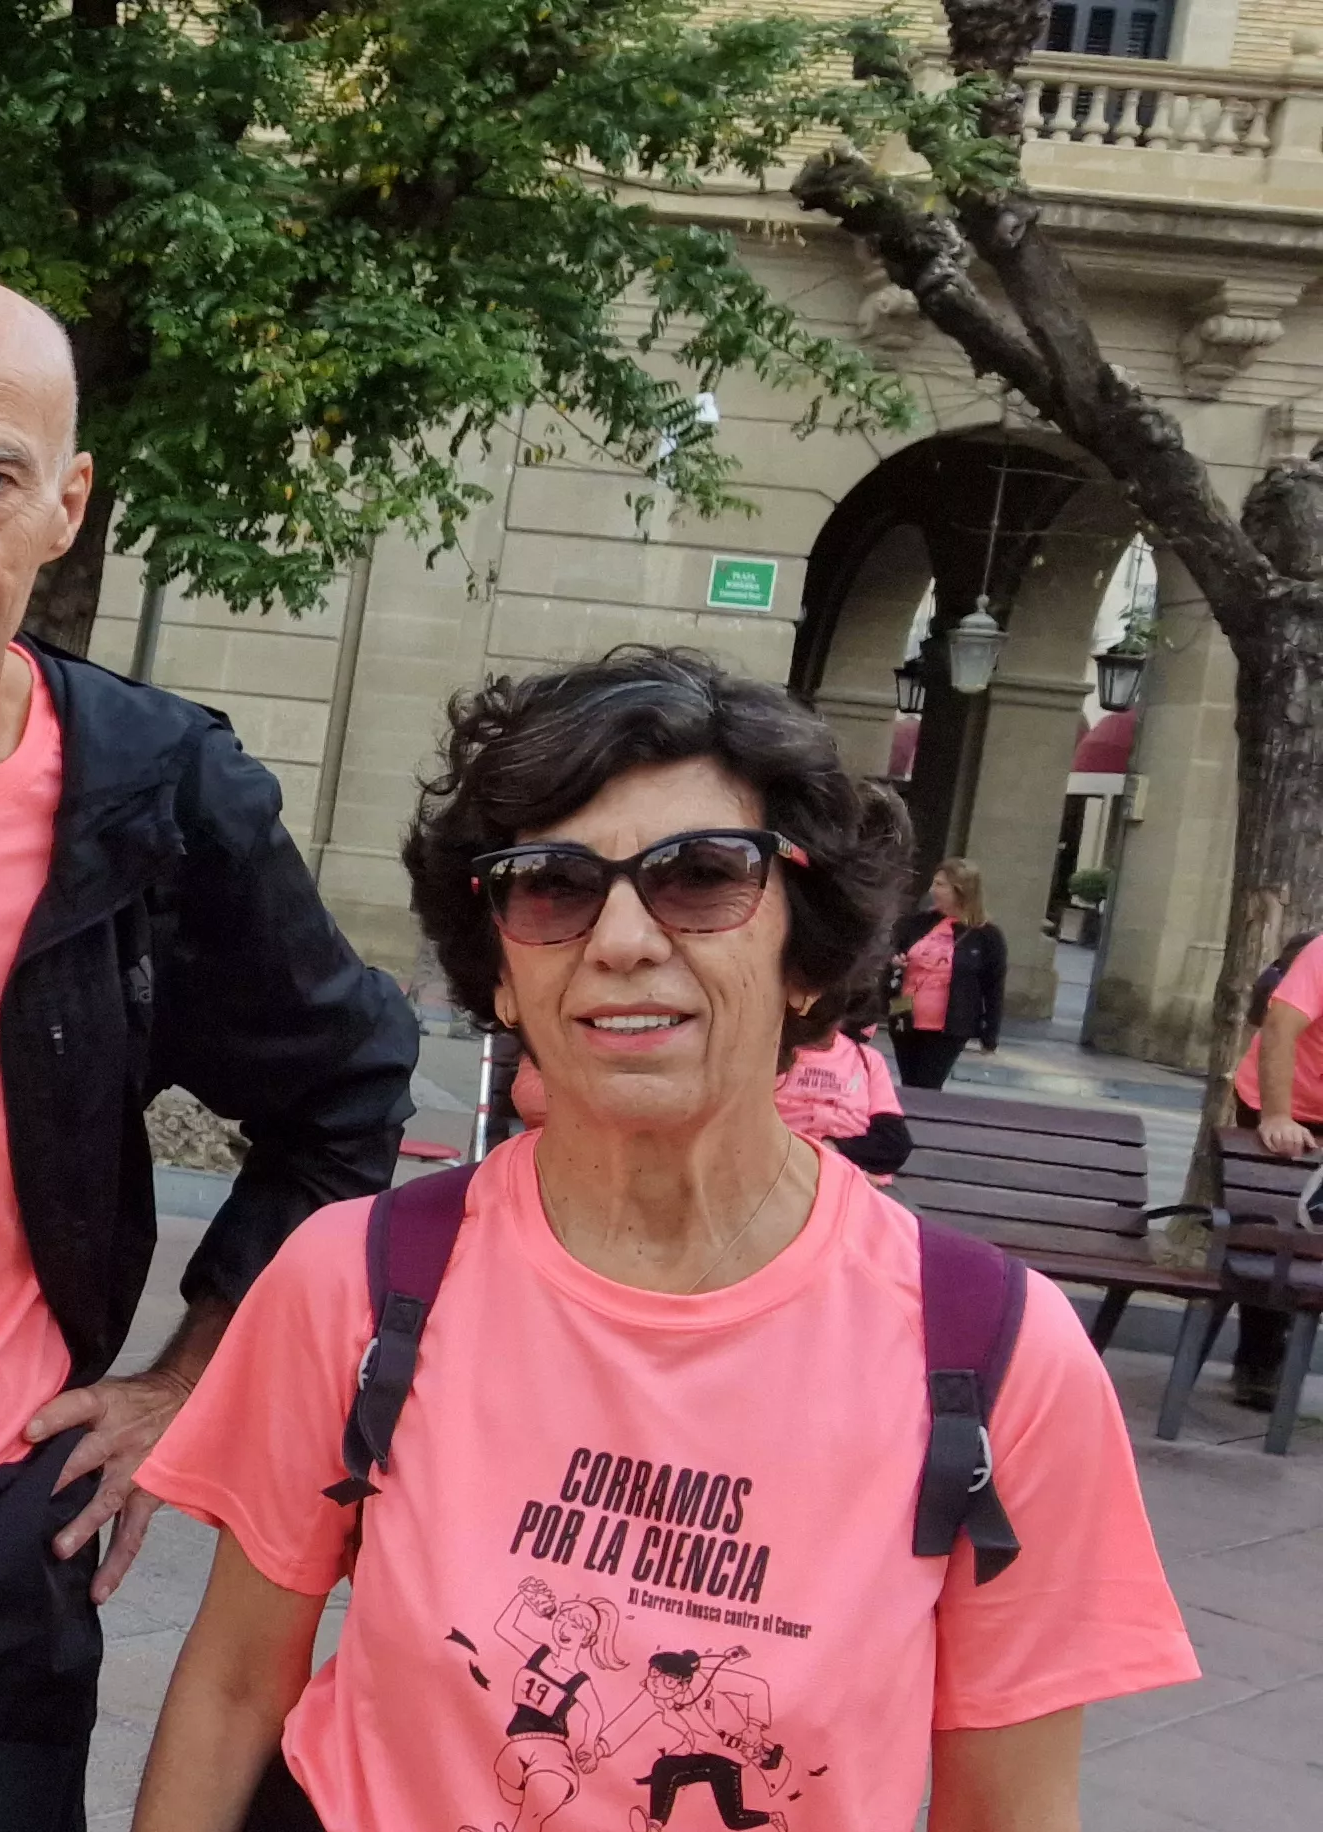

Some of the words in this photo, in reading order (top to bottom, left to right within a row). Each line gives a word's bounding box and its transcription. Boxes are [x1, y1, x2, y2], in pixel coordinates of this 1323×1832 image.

[560, 1447, 753, 1535] CORRAMOS
[509, 1500, 586, 1565] POR
[583, 1515, 630, 1576] LA
[631, 1525, 771, 1605] CIENCIA
[641, 1590, 684, 1615] Carrera
[685, 1599, 722, 1623] Huesca
[724, 1609, 760, 1631] contra
[763, 1614, 773, 1633] el
[526, 1678, 550, 1707] 19
